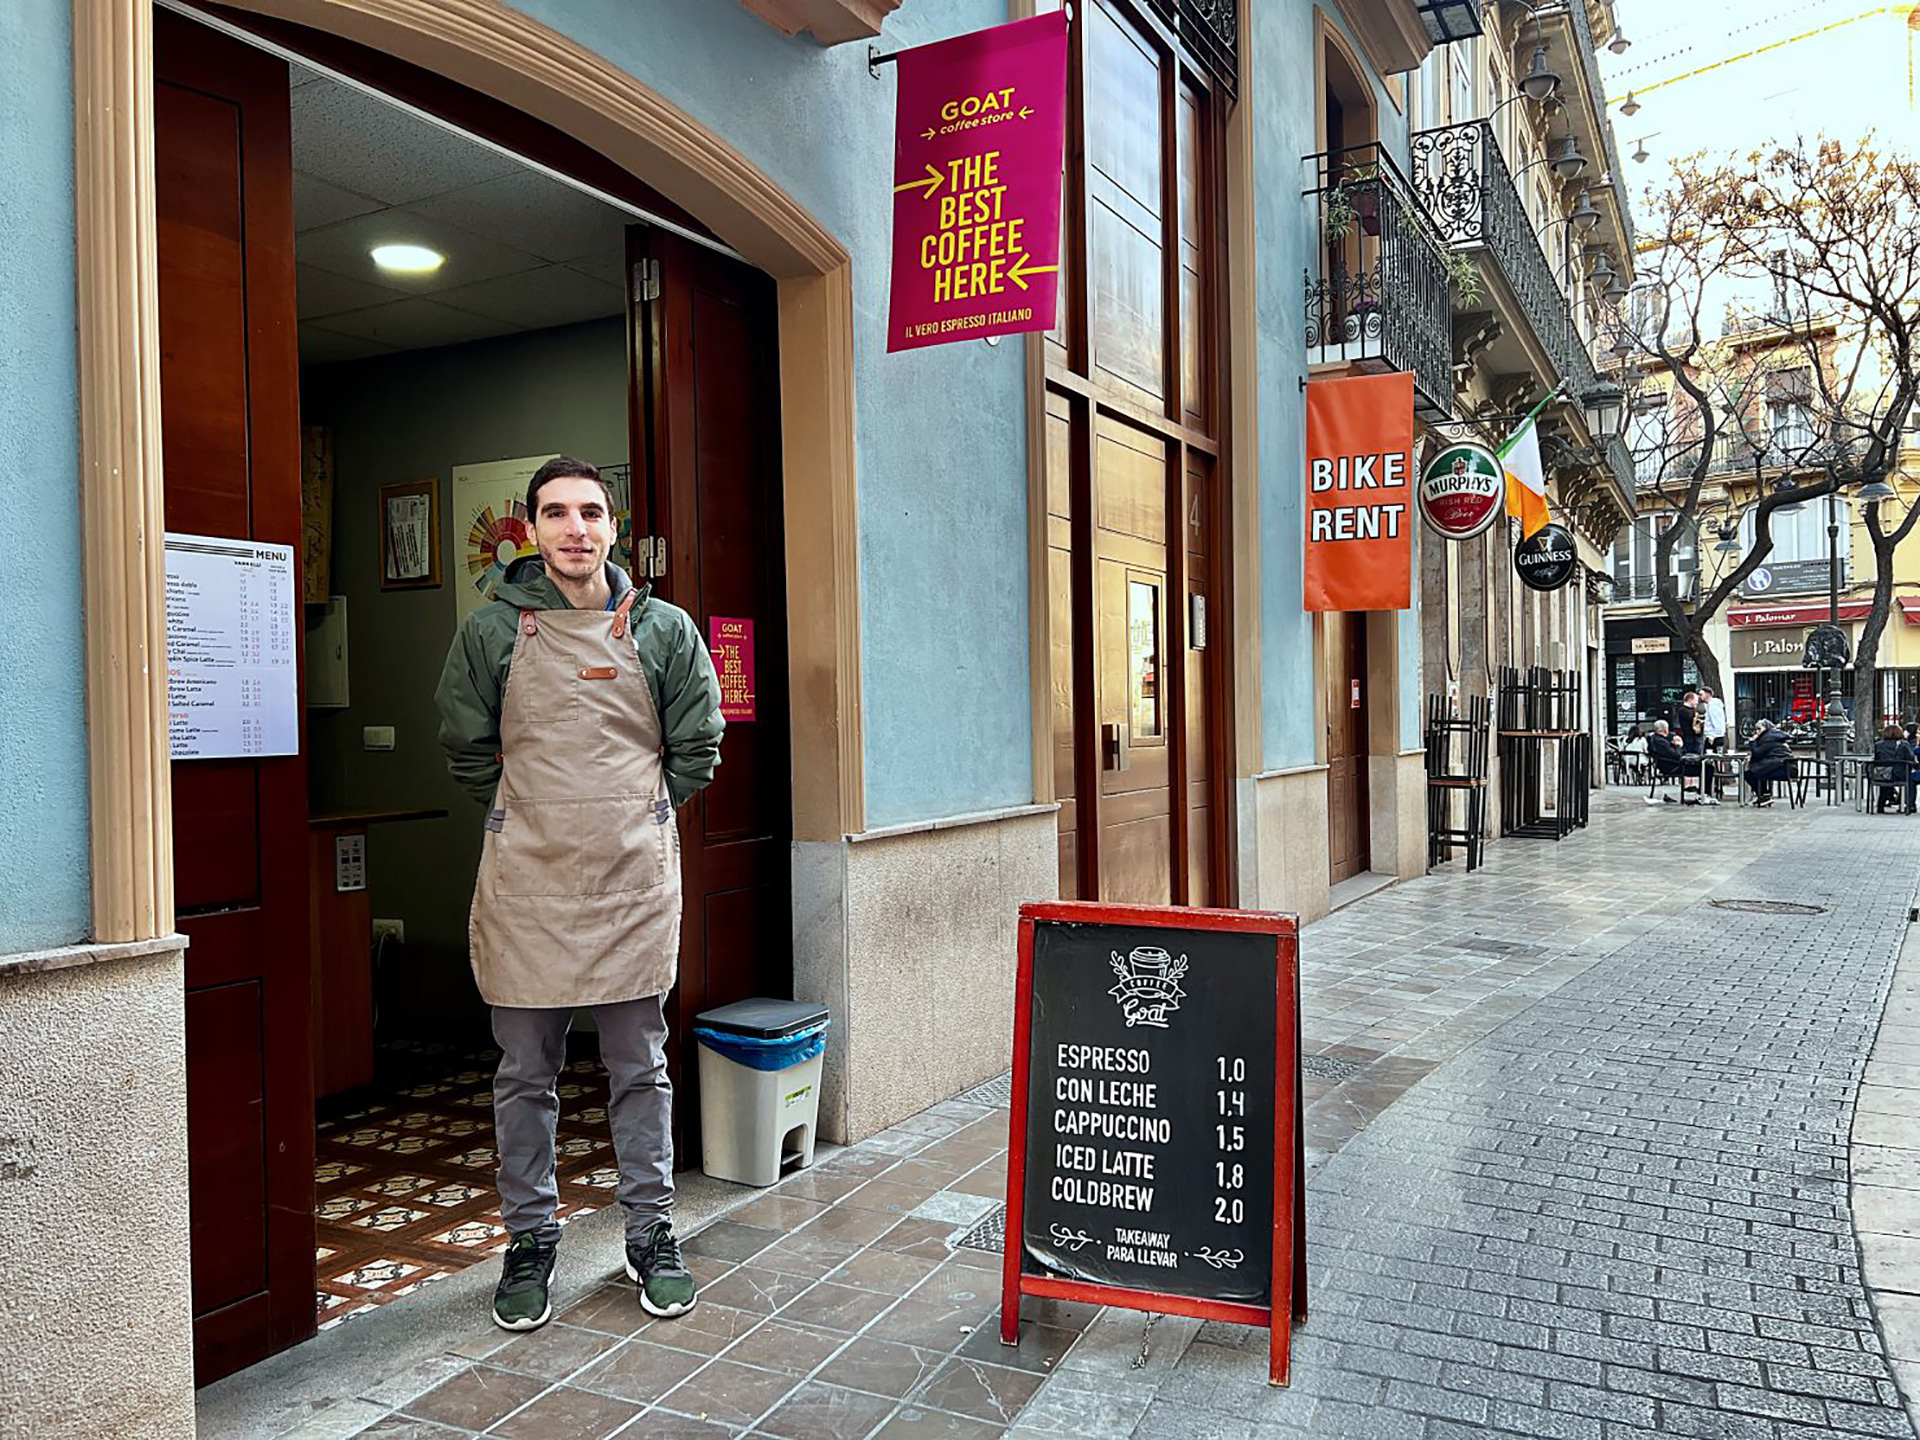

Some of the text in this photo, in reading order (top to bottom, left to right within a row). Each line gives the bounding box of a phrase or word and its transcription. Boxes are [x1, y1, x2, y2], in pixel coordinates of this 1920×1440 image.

[941, 88, 1015, 120] GOAT
[940, 111, 1014, 134] coffee store
[948, 151, 1000, 193] THE
[940, 185, 1007, 230] BEST
[921, 218, 1024, 268] COFFEE
[933, 258, 1006, 303] HERE
[905, 308, 1032, 338] IL VERO ESPRESSO ITALIANO
[1311, 452, 1405, 493] BIKE
[1189, 494, 1200, 536] 4
[1311, 503, 1405, 542] RENT
[256, 550, 287, 562] MENU
[1518, 549, 1572, 566] GUINNESS
[722, 623, 743, 633] GOAT
[1755, 613, 1796, 622] Palomar
[725, 645, 740, 659] THE
[1753, 640, 1762, 657] J.
[720, 675, 747, 689] COFFEE
[724, 660, 742, 674] BEST
[724, 689, 744, 704] HERE
[1130, 979, 1168, 990] COFFEE
[1123, 998, 1168, 1028] Goat
[1057, 1044, 1150, 1074] ESPRESSO
[1056, 1077, 1093, 1103] CON
[1099, 1080, 1157, 1109] LECHE
[1054, 1109, 1171, 1144] CAPPUCCINO
[1056, 1144, 1096, 1171] ICED
[1102, 1150, 1155, 1180] LATTE
[1051, 1176, 1154, 1213] COLDBREW
[1115, 1228, 1171, 1249] TAKEAWAY
[1107, 1245, 1178, 1268] PARA LLEVAR
